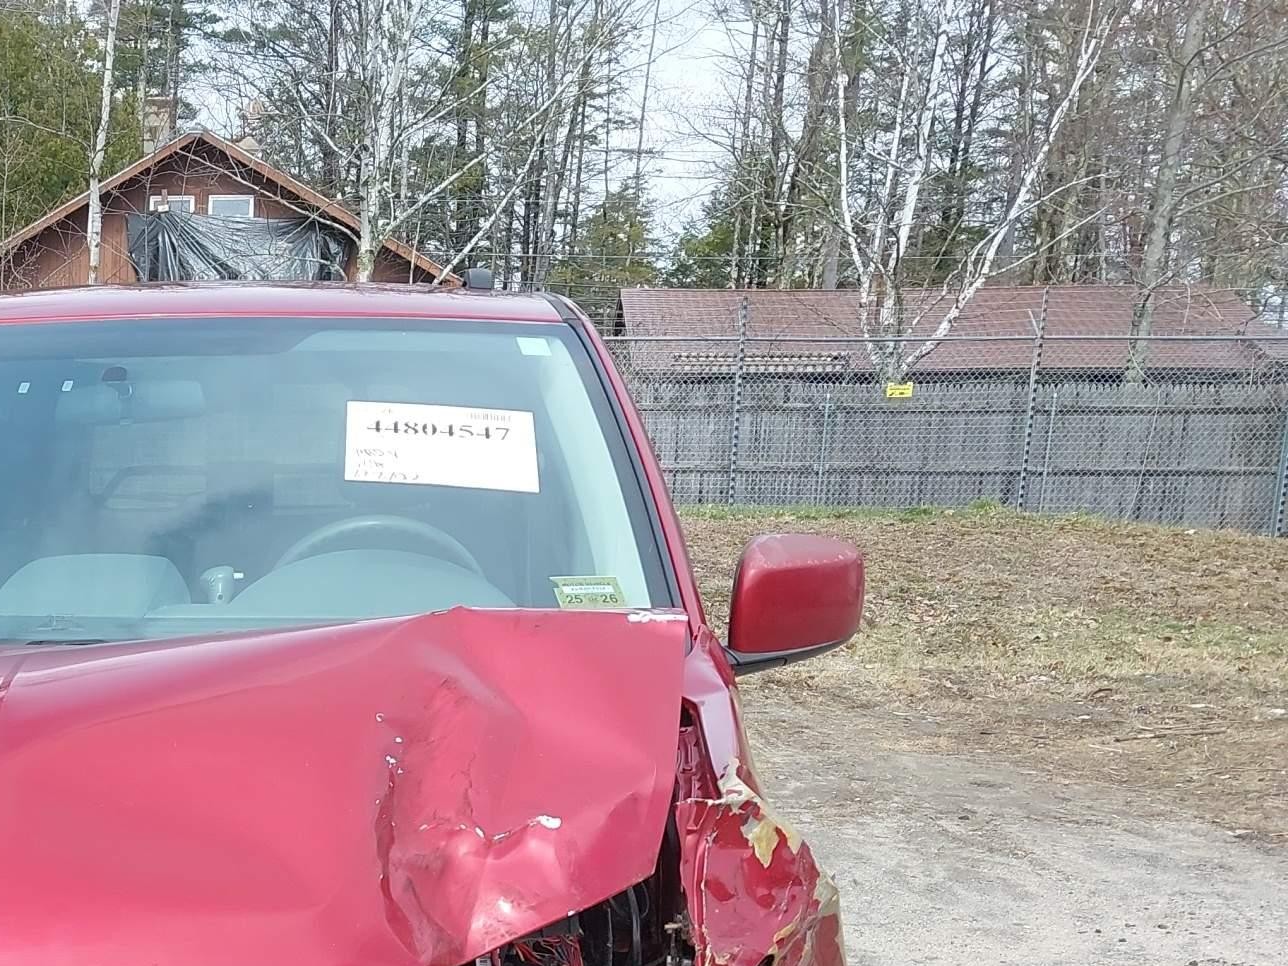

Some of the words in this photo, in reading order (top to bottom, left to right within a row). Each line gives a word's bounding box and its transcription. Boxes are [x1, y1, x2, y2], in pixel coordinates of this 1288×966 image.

[365, 419, 511, 441] 44804547
[566, 594, 583, 604] 25
[600, 593, 618, 603] 26
